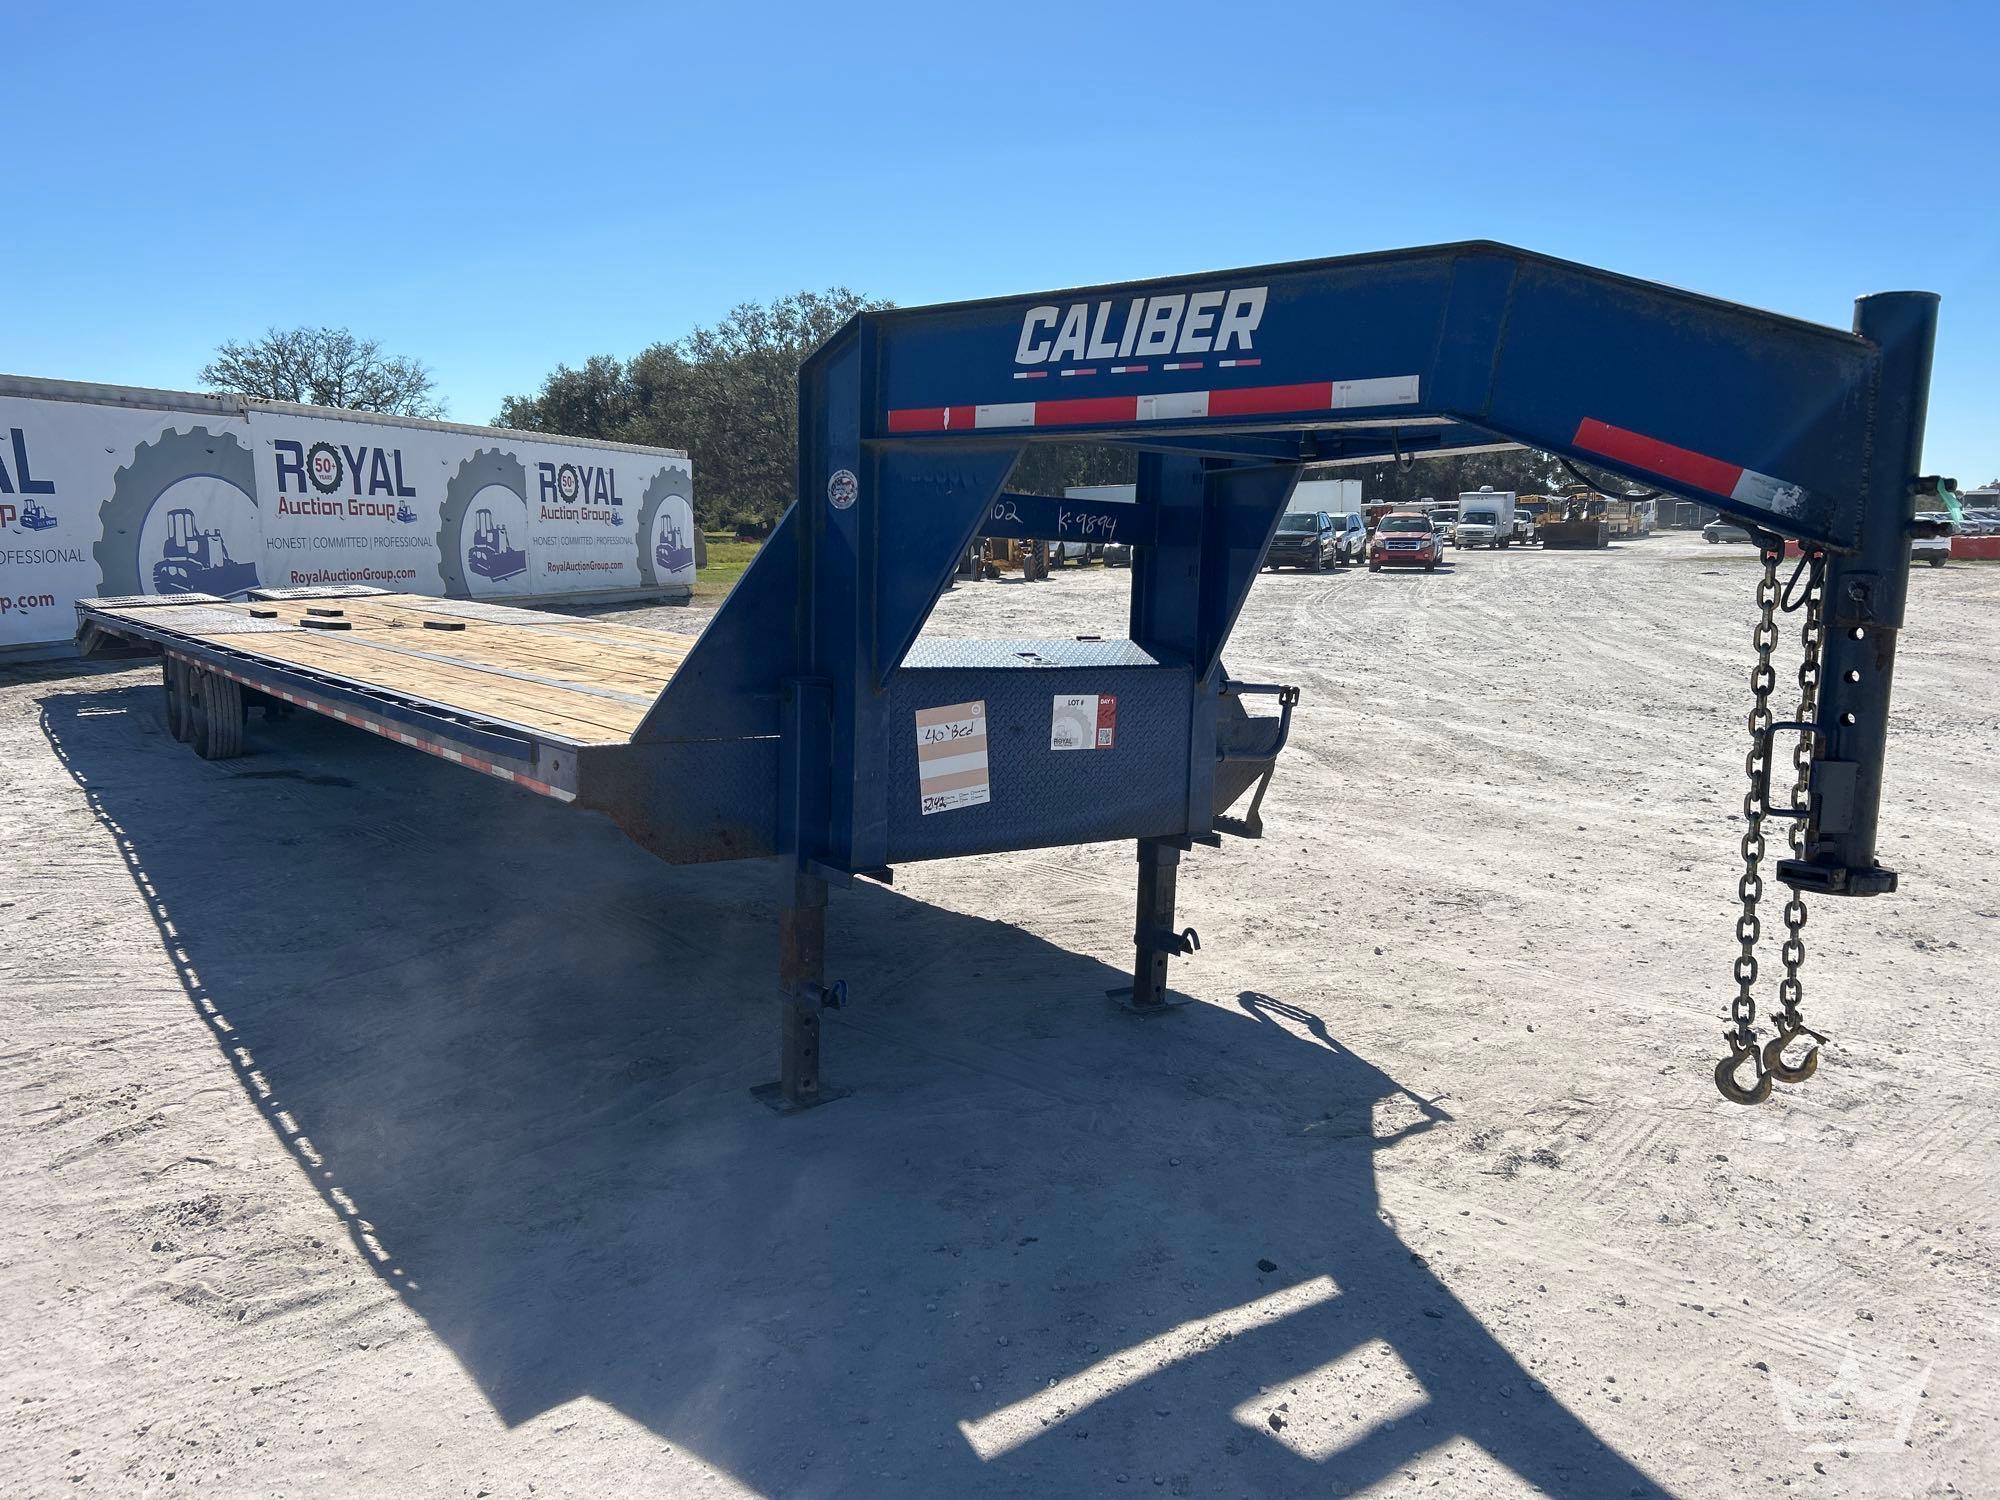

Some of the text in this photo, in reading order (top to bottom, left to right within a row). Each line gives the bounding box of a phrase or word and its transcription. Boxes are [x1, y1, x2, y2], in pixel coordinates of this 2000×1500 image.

[1014, 286, 1268, 365] CALIBER
[275, 440, 417, 497] ROYAL
[315, 458, 336, 473] 50+
[539, 462, 623, 506] ROYAL
[278, 496, 395, 520] Auction Group
[541, 505, 610, 525] Auction Group
[990, 501, 1024, 524] 102
[266, 536, 433, 550] HONEST COMMITTED PROFESSIONAL
[533, 536, 633, 546] HONEST COMMITTED PROFESSIONAL
[290, 568, 416, 586] RoyalAuctionGroup.com
[547, 561, 623, 575] RoyalAuctionGroup.com
